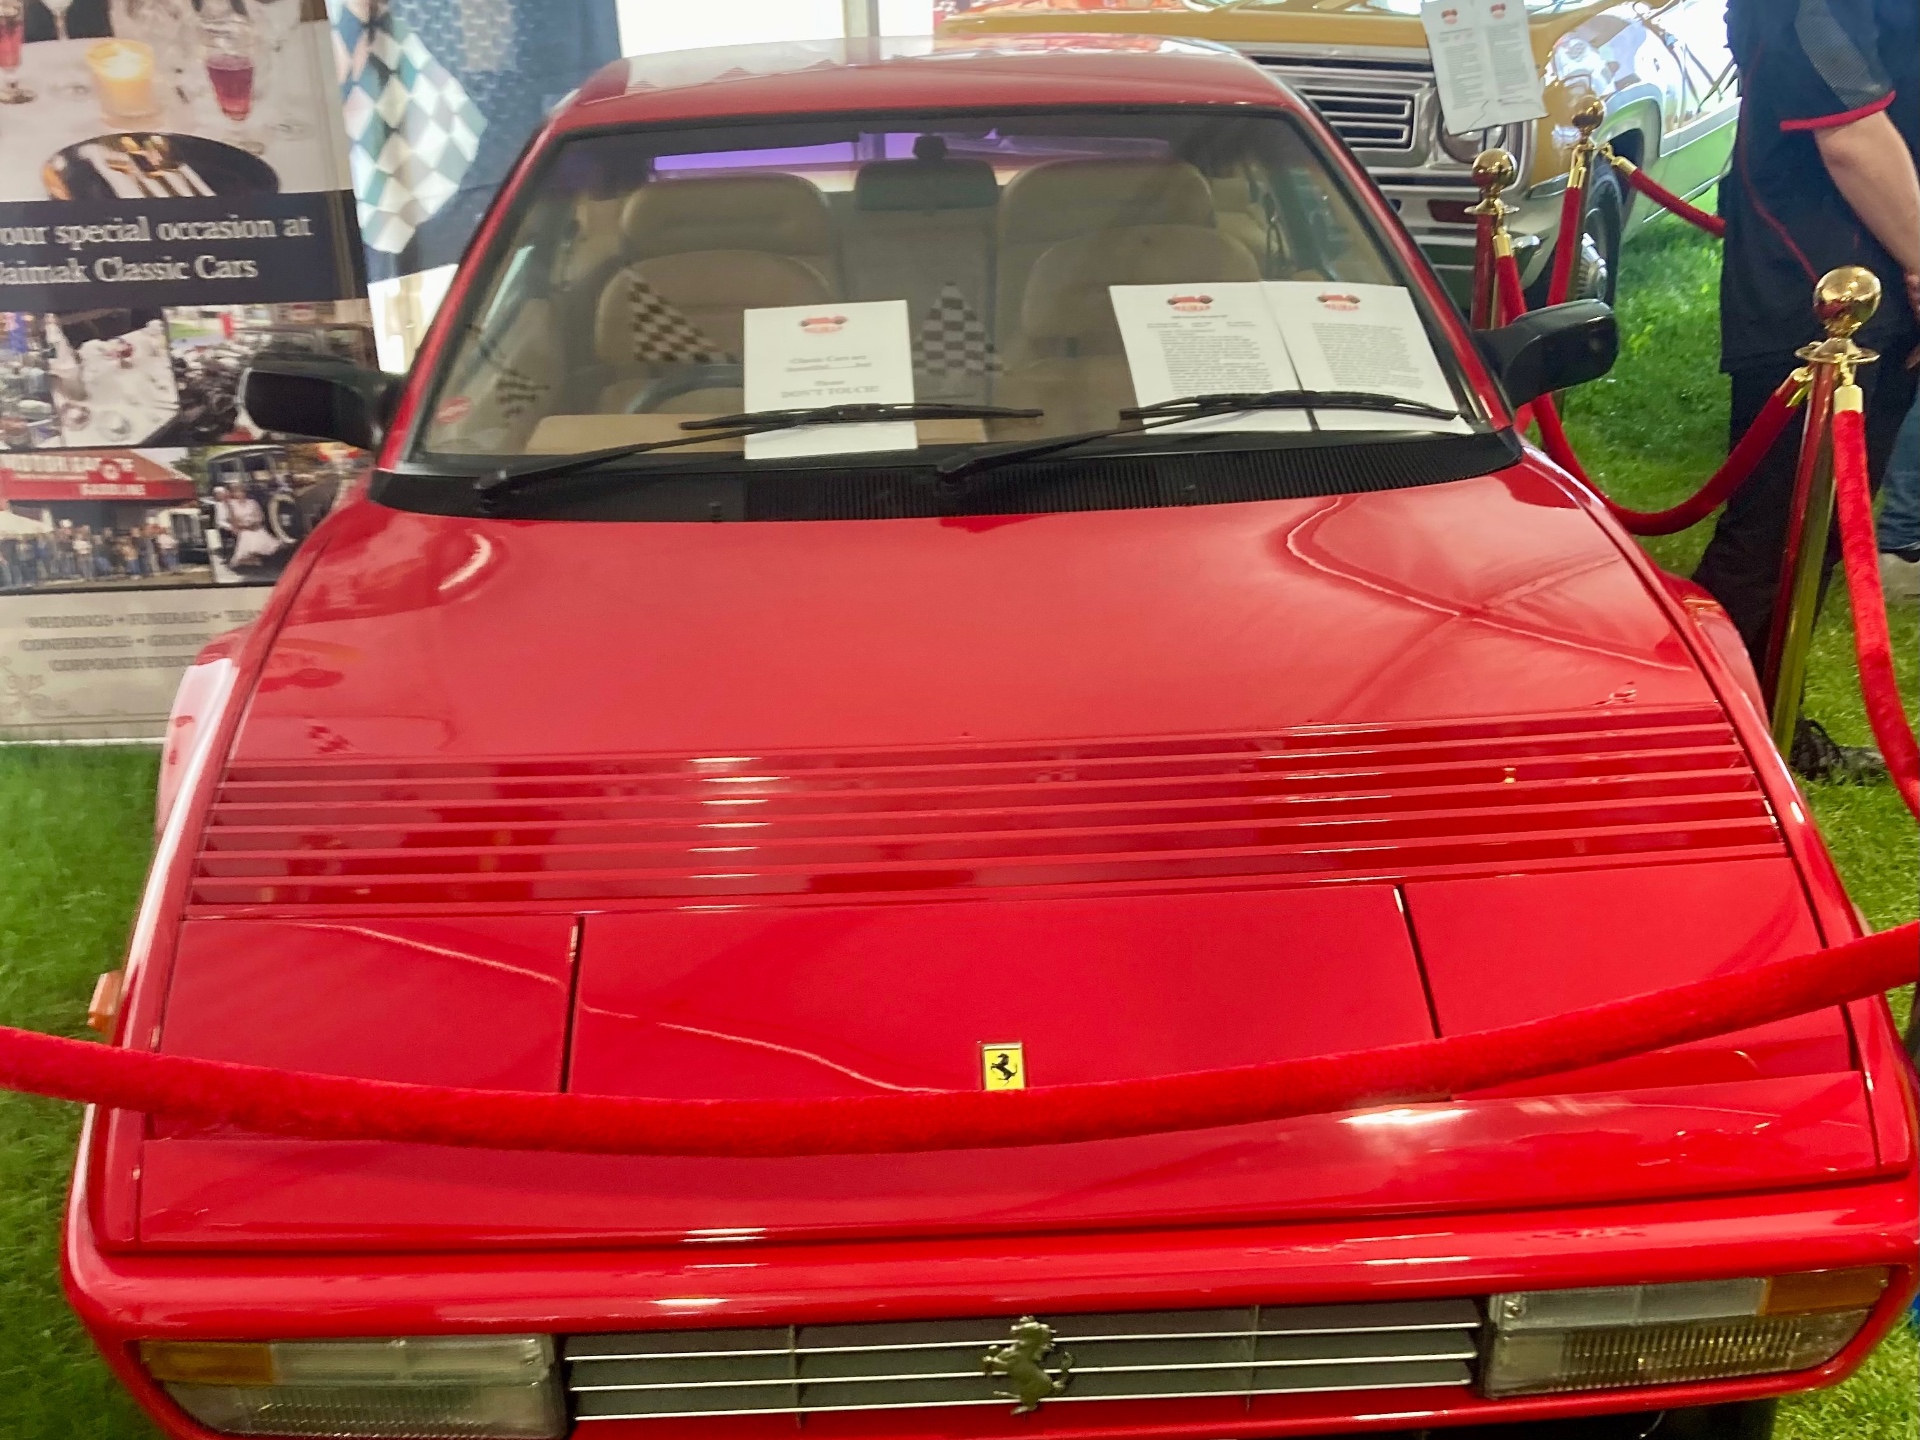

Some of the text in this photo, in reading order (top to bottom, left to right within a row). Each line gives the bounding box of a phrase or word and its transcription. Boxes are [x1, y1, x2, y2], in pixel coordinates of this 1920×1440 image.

[0, 214, 314, 251] our special occasion at
[0, 254, 259, 285] aimak Classic Cars
